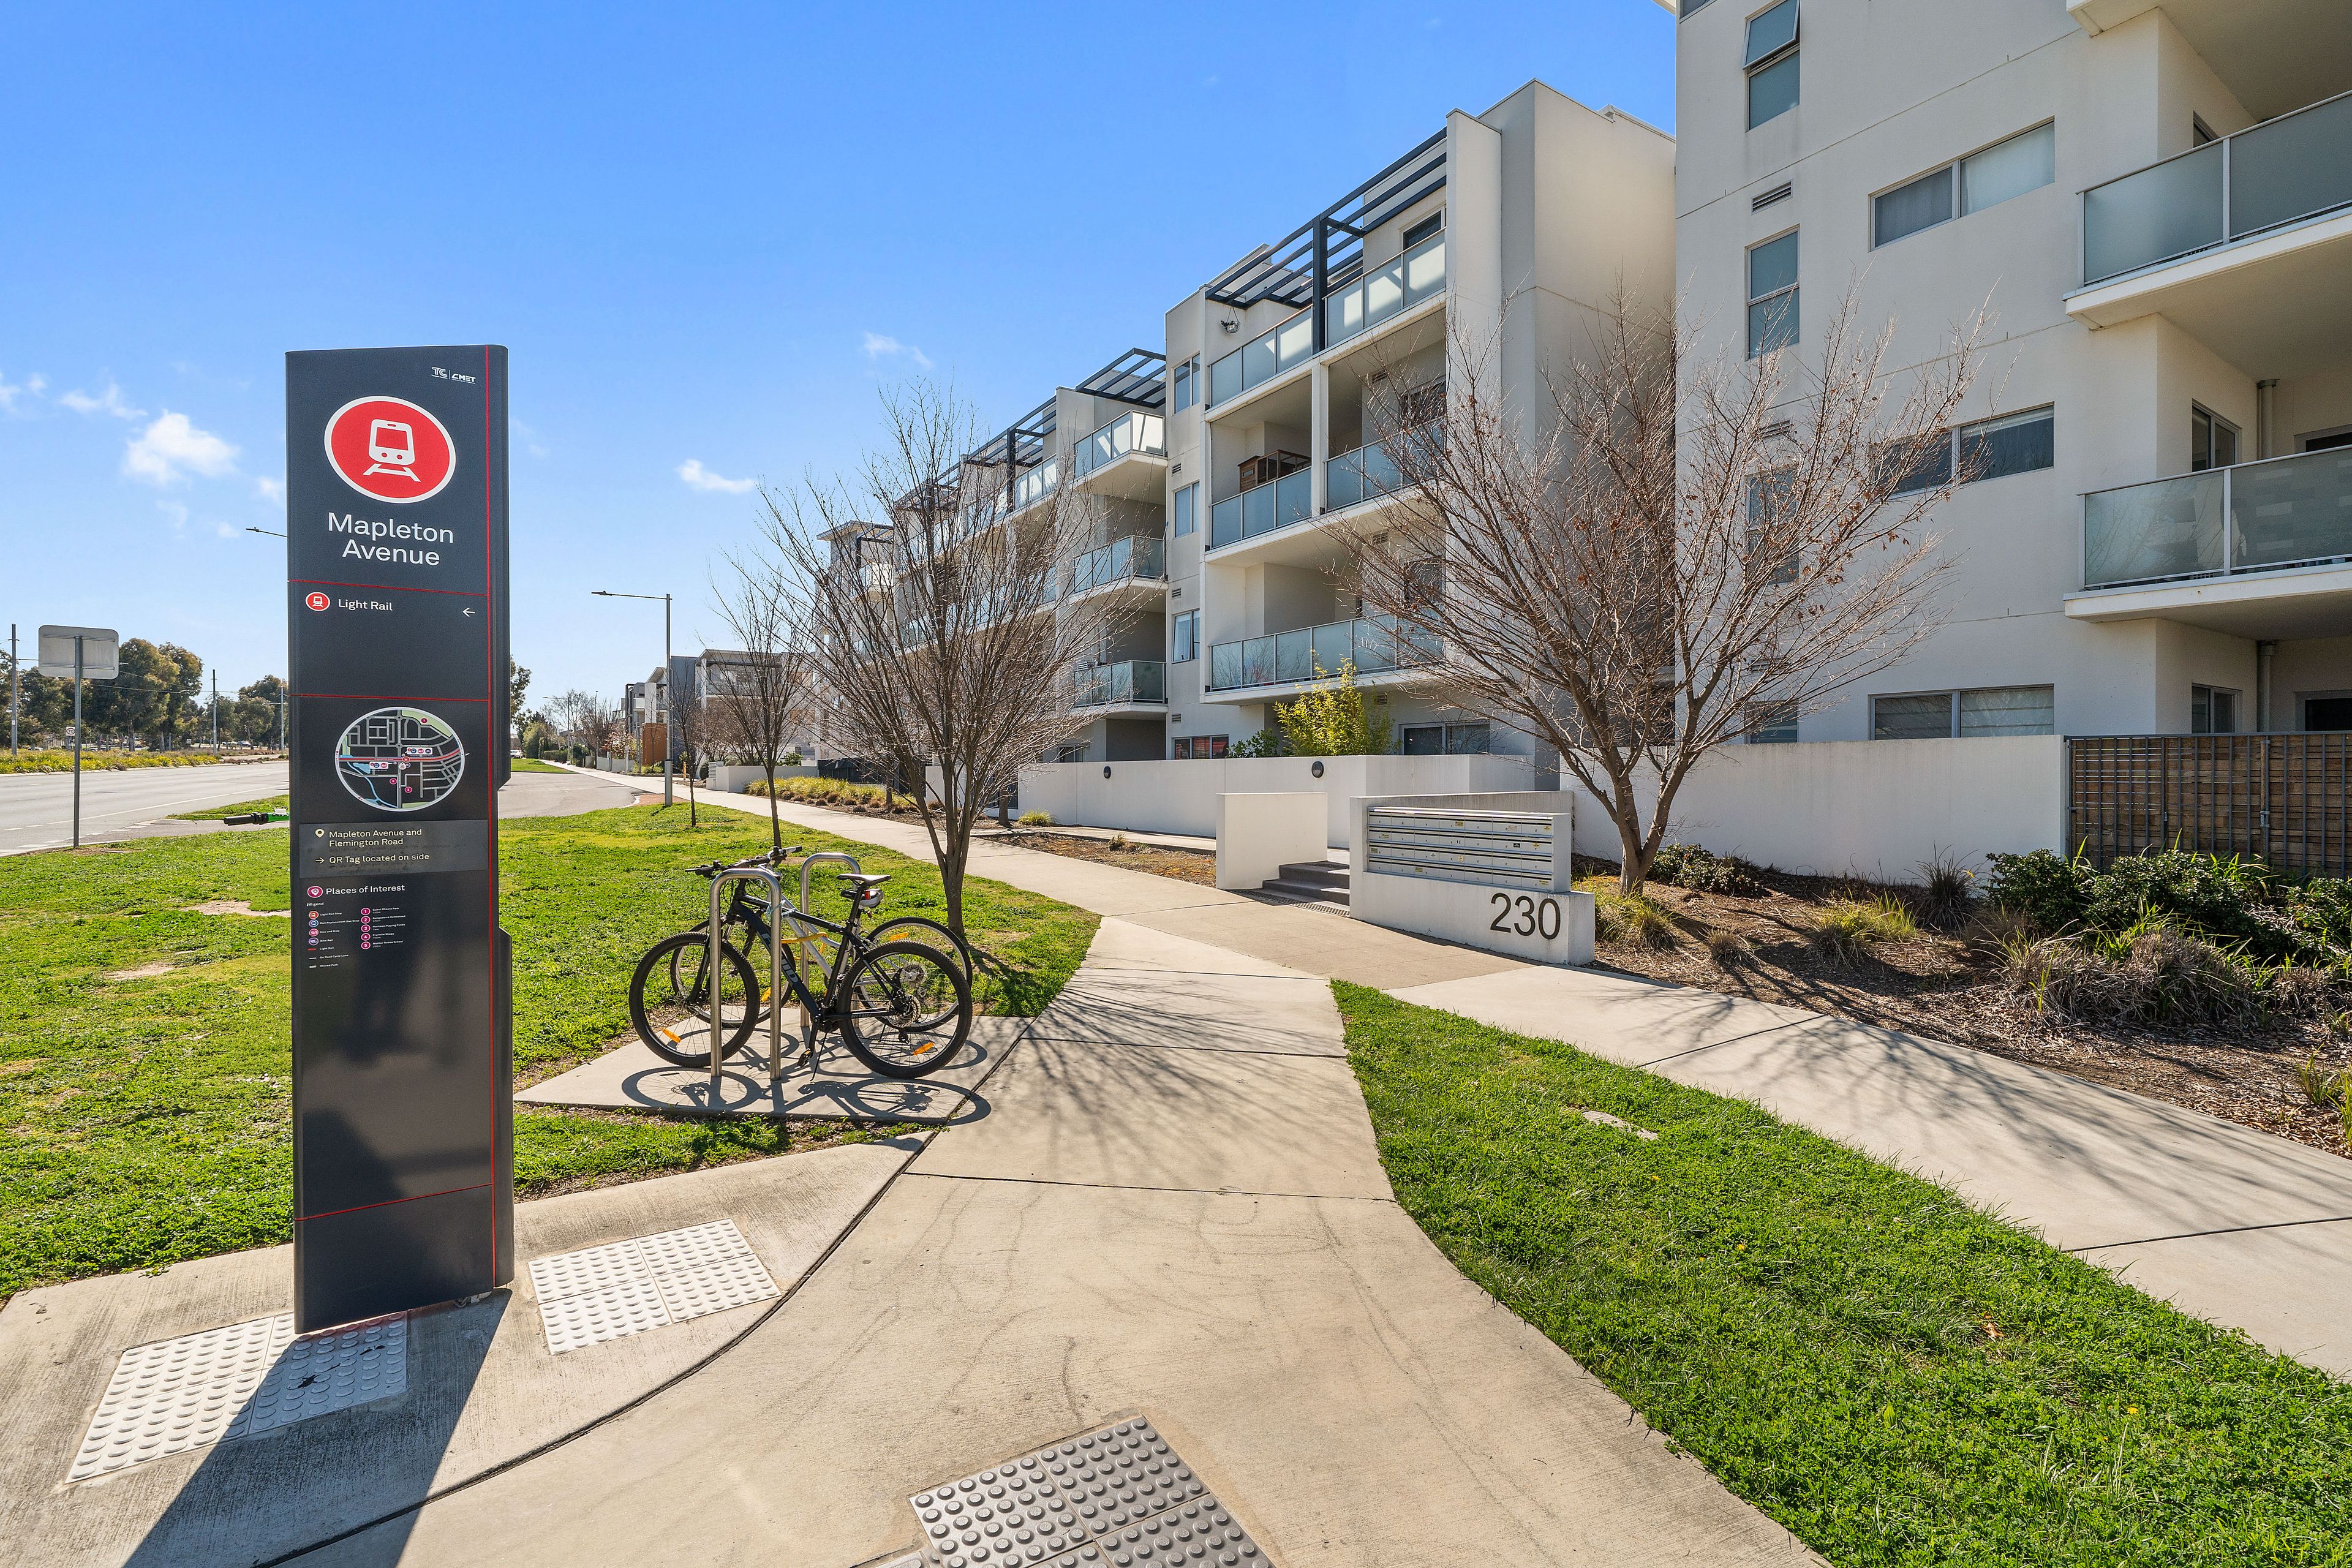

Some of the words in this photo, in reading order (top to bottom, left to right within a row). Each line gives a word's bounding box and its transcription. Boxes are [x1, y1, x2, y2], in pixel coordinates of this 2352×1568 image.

[431, 366, 448, 377] TC
[328, 512, 453, 543] Mapleton
[342, 539, 440, 565] Avenue
[338, 598, 368, 610] Light
[371, 601, 393, 611] Rail
[329, 831, 371, 839] Mapleton
[344, 856, 361, 864] Tag
[1490, 892, 1561, 940] 230
